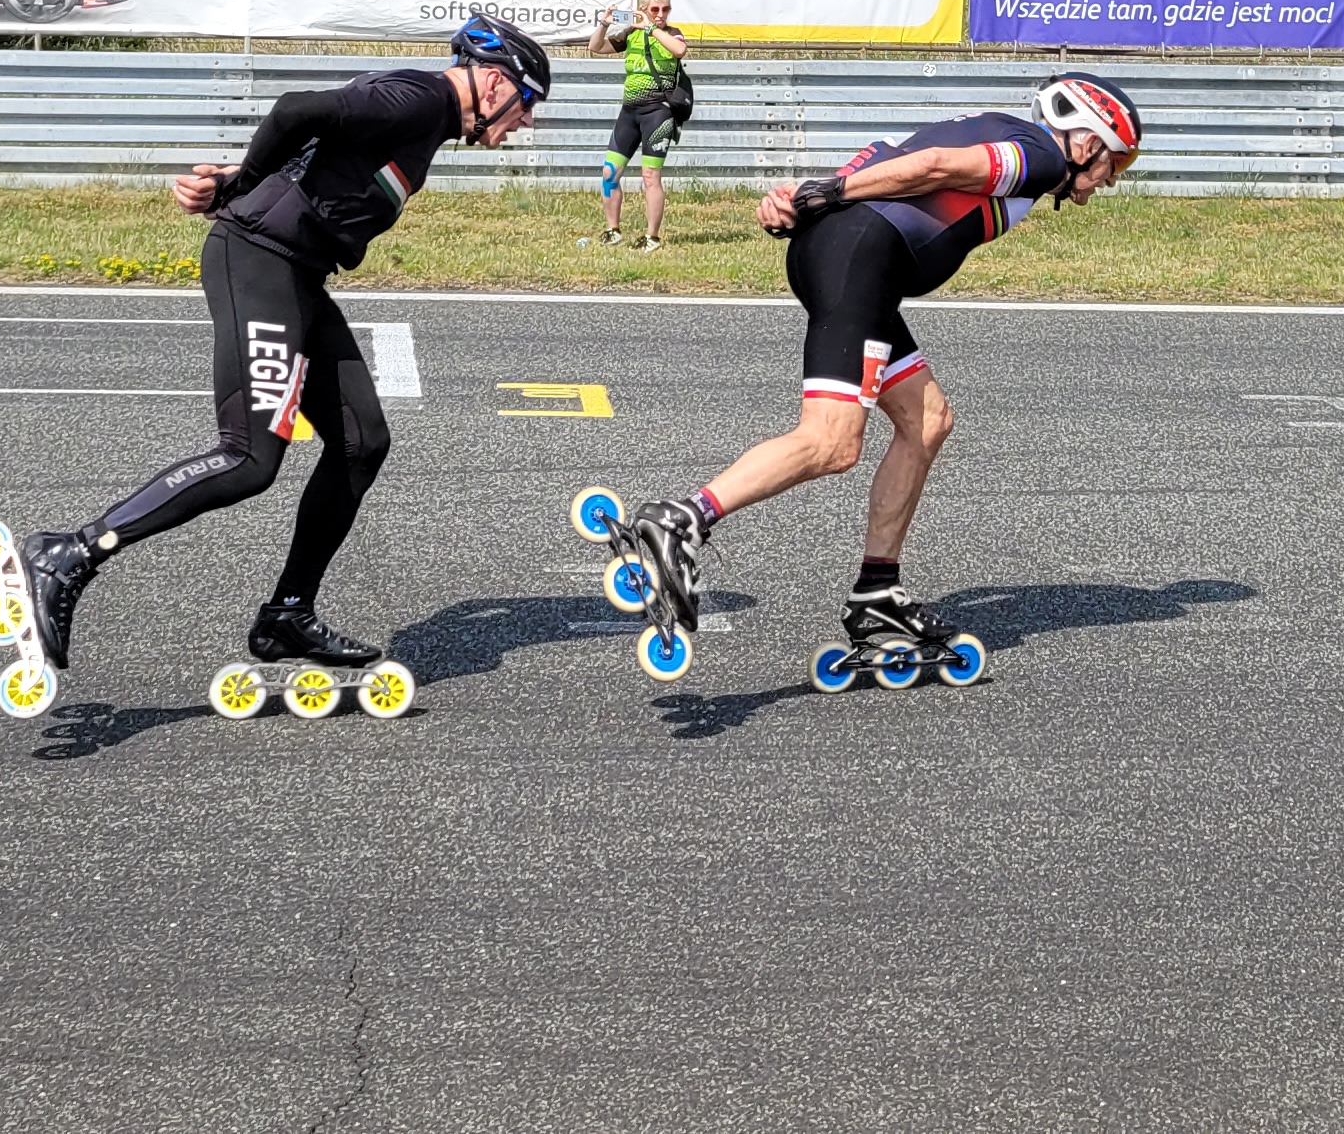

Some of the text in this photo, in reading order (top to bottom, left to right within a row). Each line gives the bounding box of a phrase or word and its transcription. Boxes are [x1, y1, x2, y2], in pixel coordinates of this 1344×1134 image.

[1107, 0, 1158, 23] tam,
[1163, 0, 1226, 26] gdzie
[1225, 0, 1274, 27] jest
[1278, 1, 1335, 24] moc!
[923, 65, 936, 74] 27
[247, 321, 289, 412] LEGIA
